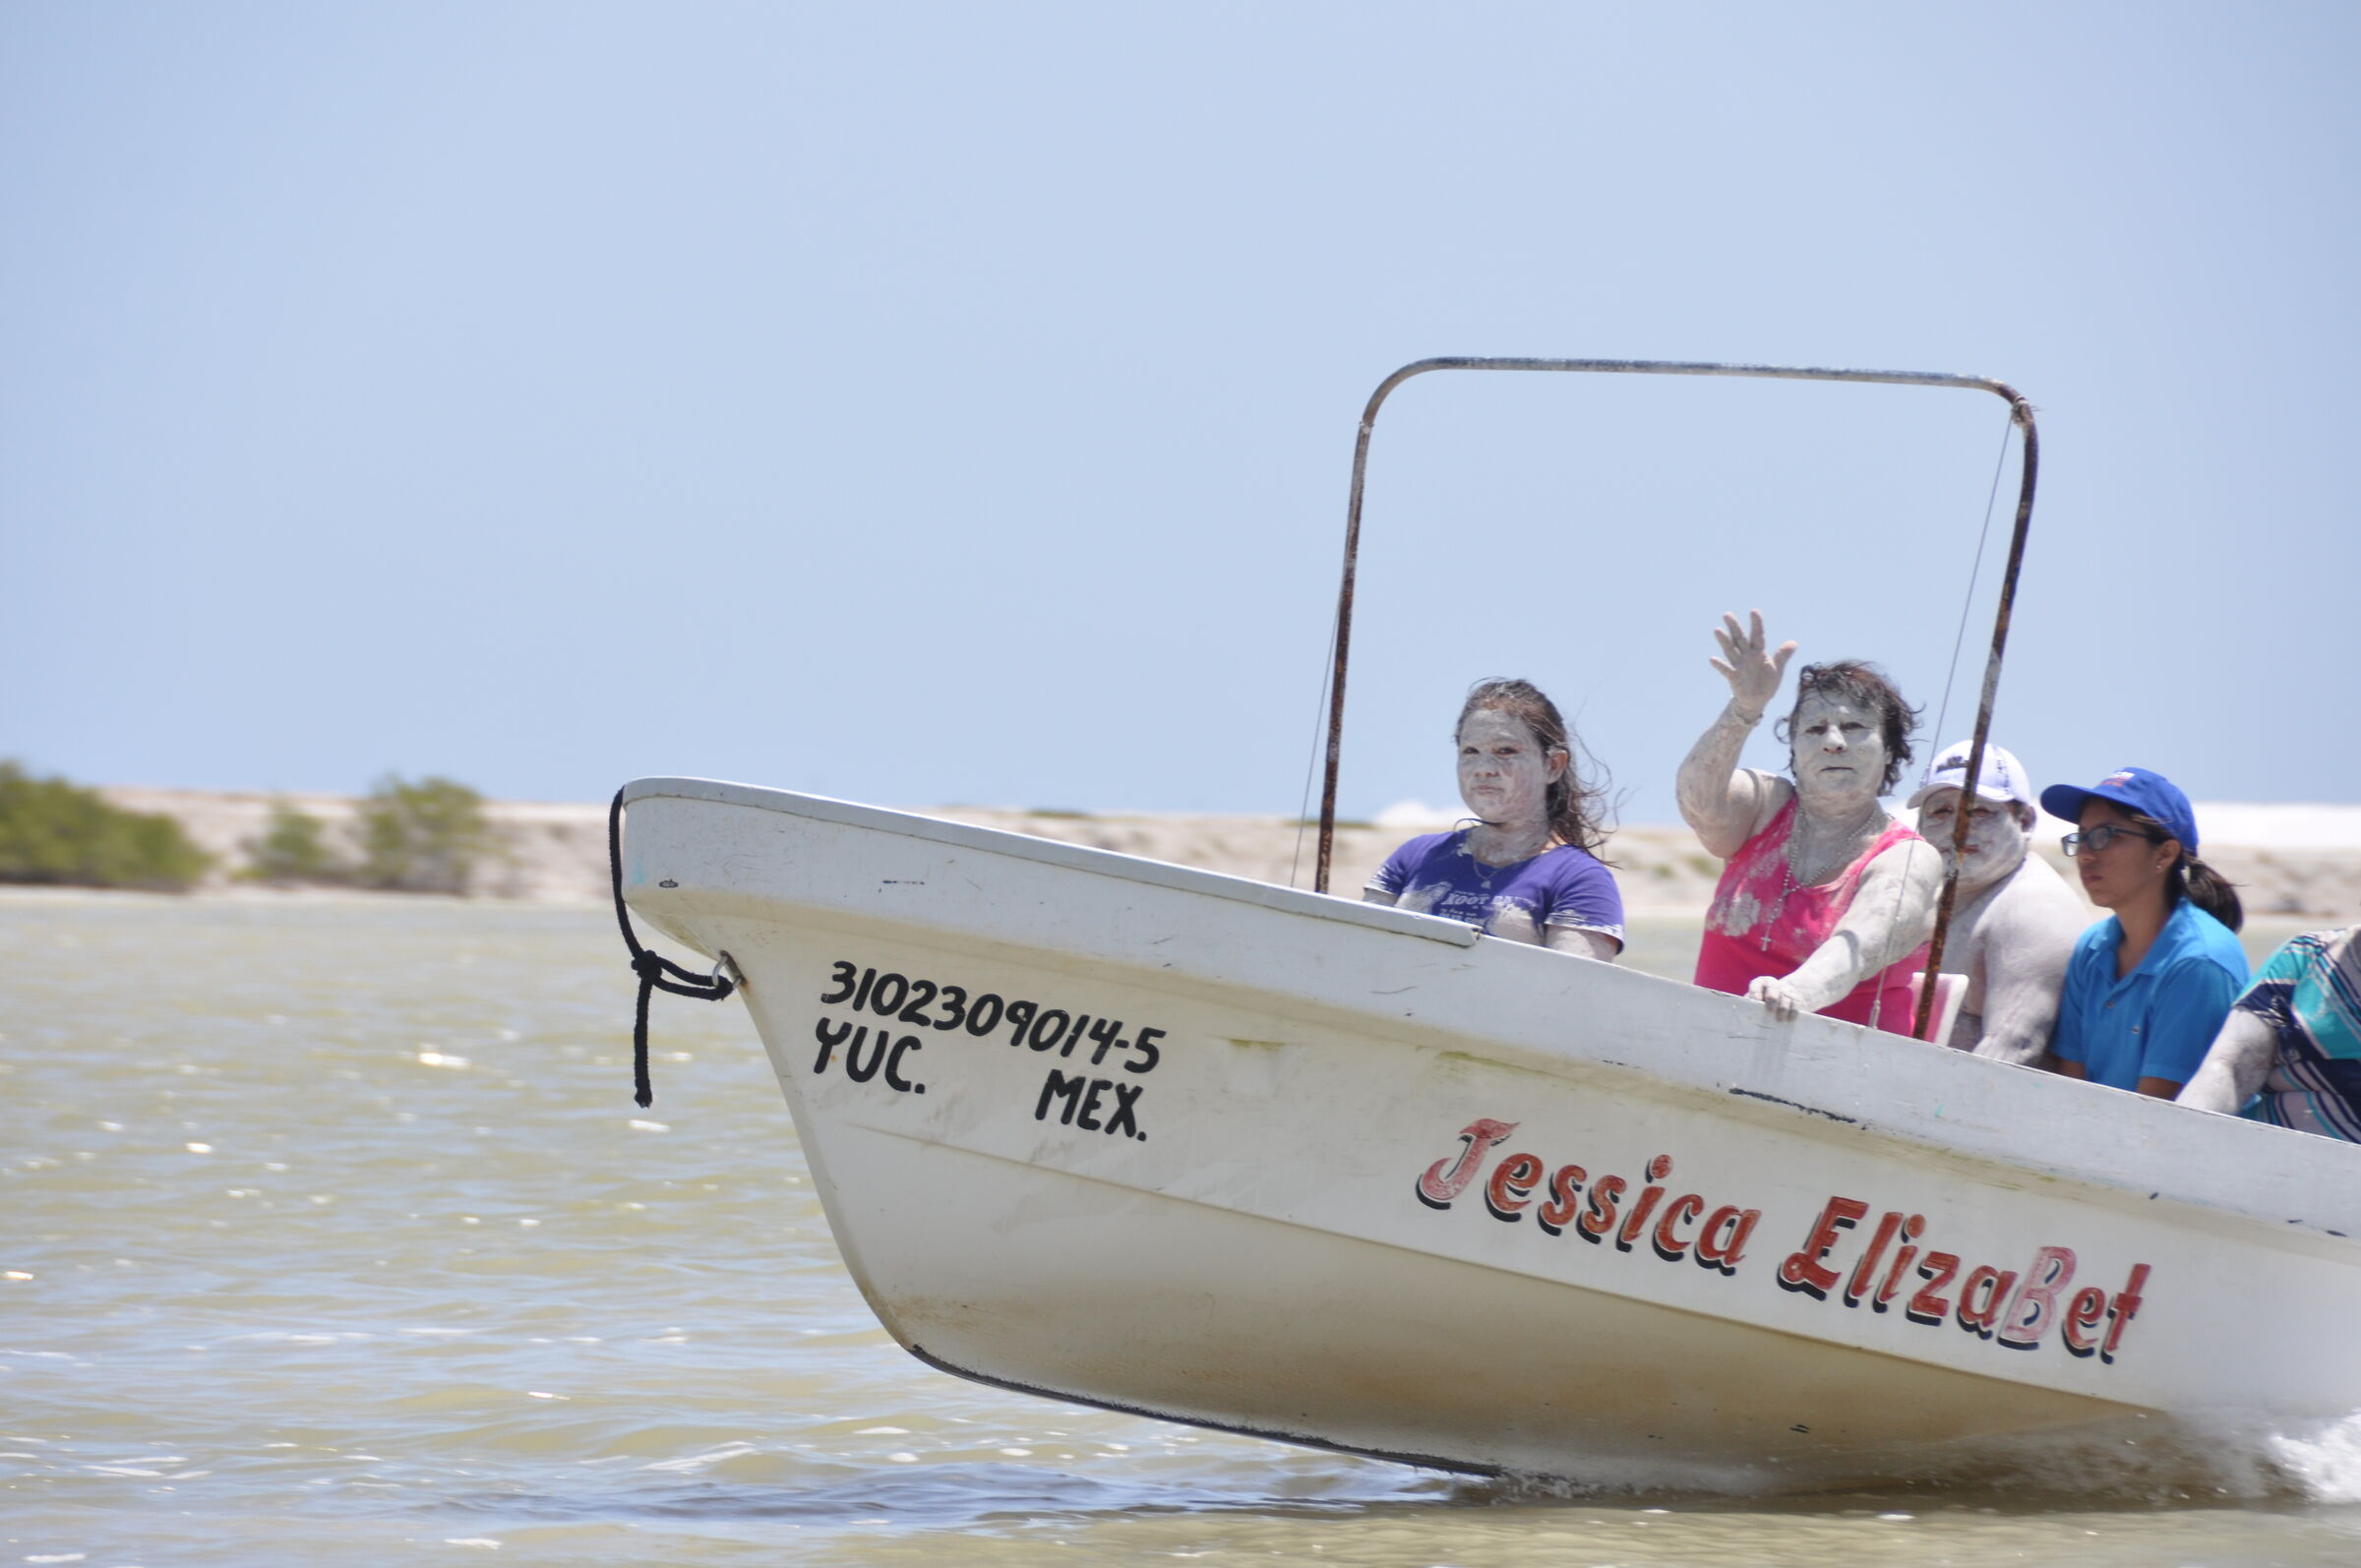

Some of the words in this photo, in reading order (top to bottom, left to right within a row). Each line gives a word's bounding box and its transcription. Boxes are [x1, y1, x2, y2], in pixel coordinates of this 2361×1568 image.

[813, 1016, 926, 1095] YUC.
[1034, 1068, 1147, 1142] MEX.
[820, 960, 1167, 1074] 3102309014-5
[1416, 1117, 1762, 1277] Jessica
[1776, 1195, 2152, 1365] ElizaBet
